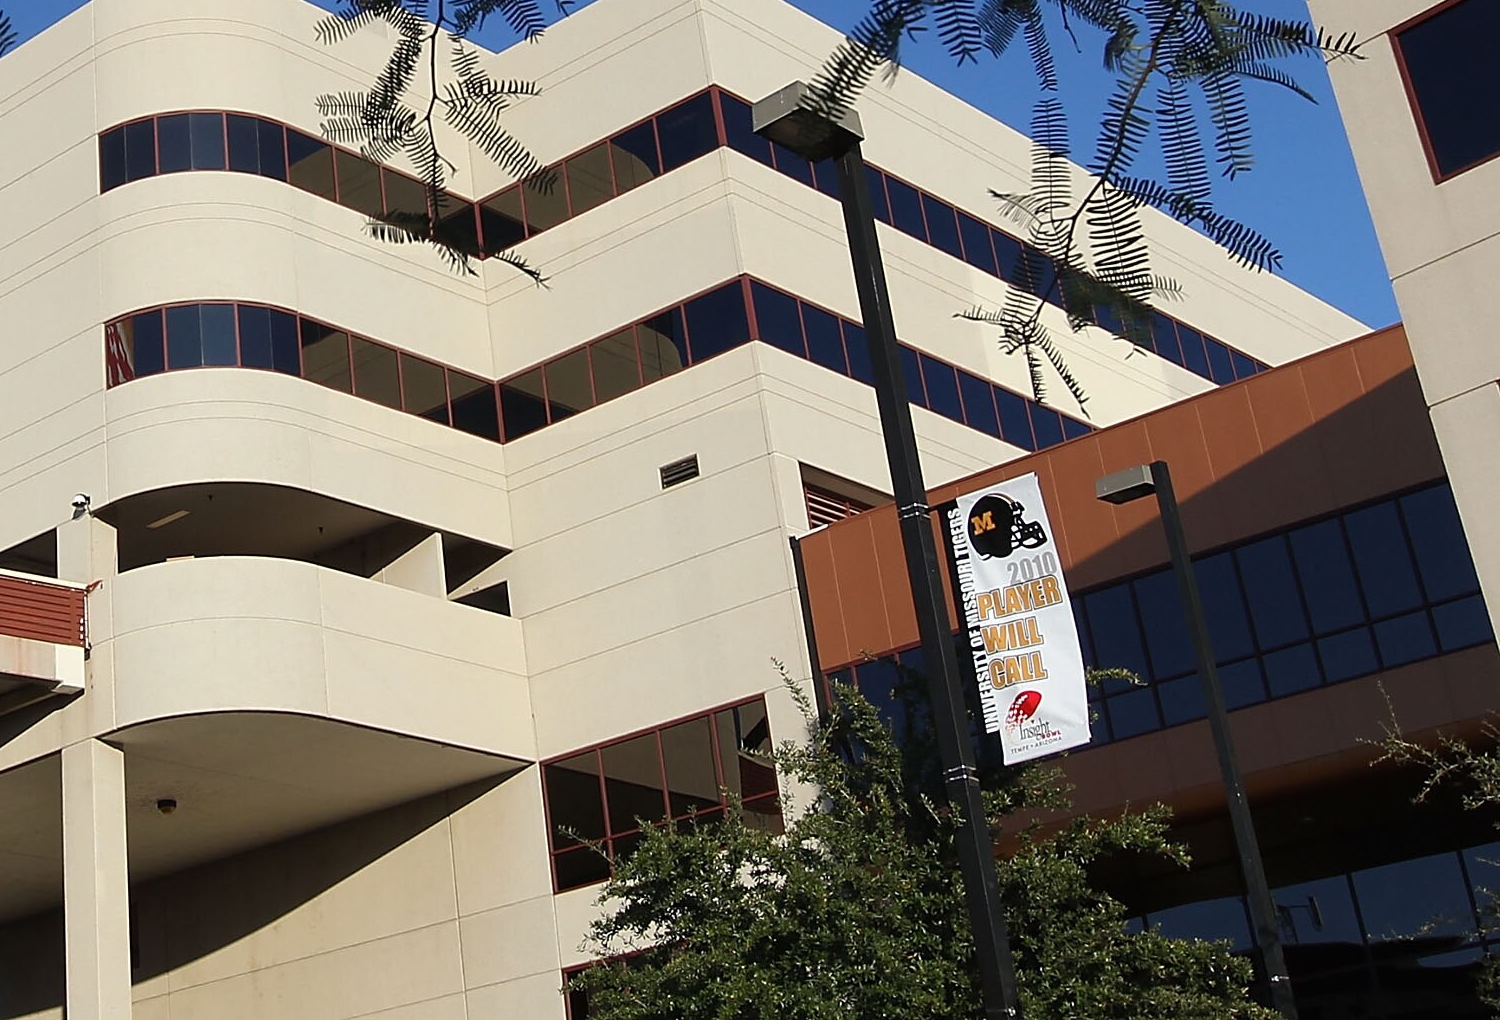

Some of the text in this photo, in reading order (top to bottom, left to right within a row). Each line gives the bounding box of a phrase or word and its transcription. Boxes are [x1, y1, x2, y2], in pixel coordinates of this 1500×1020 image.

[1007, 551, 1058, 585] 2010
[976, 575, 1063, 620] PLAYER
[947, 507, 1000, 734] UNIVERSITY OF MISSOURI TIGERS
[980, 616, 1044, 655] WILL
[988, 651, 1048, 690] CALL
[1019, 717, 1050, 741] Insight
[1041, 730, 1062, 740] BOWL
[1011, 744, 1029, 755] TEMPE
